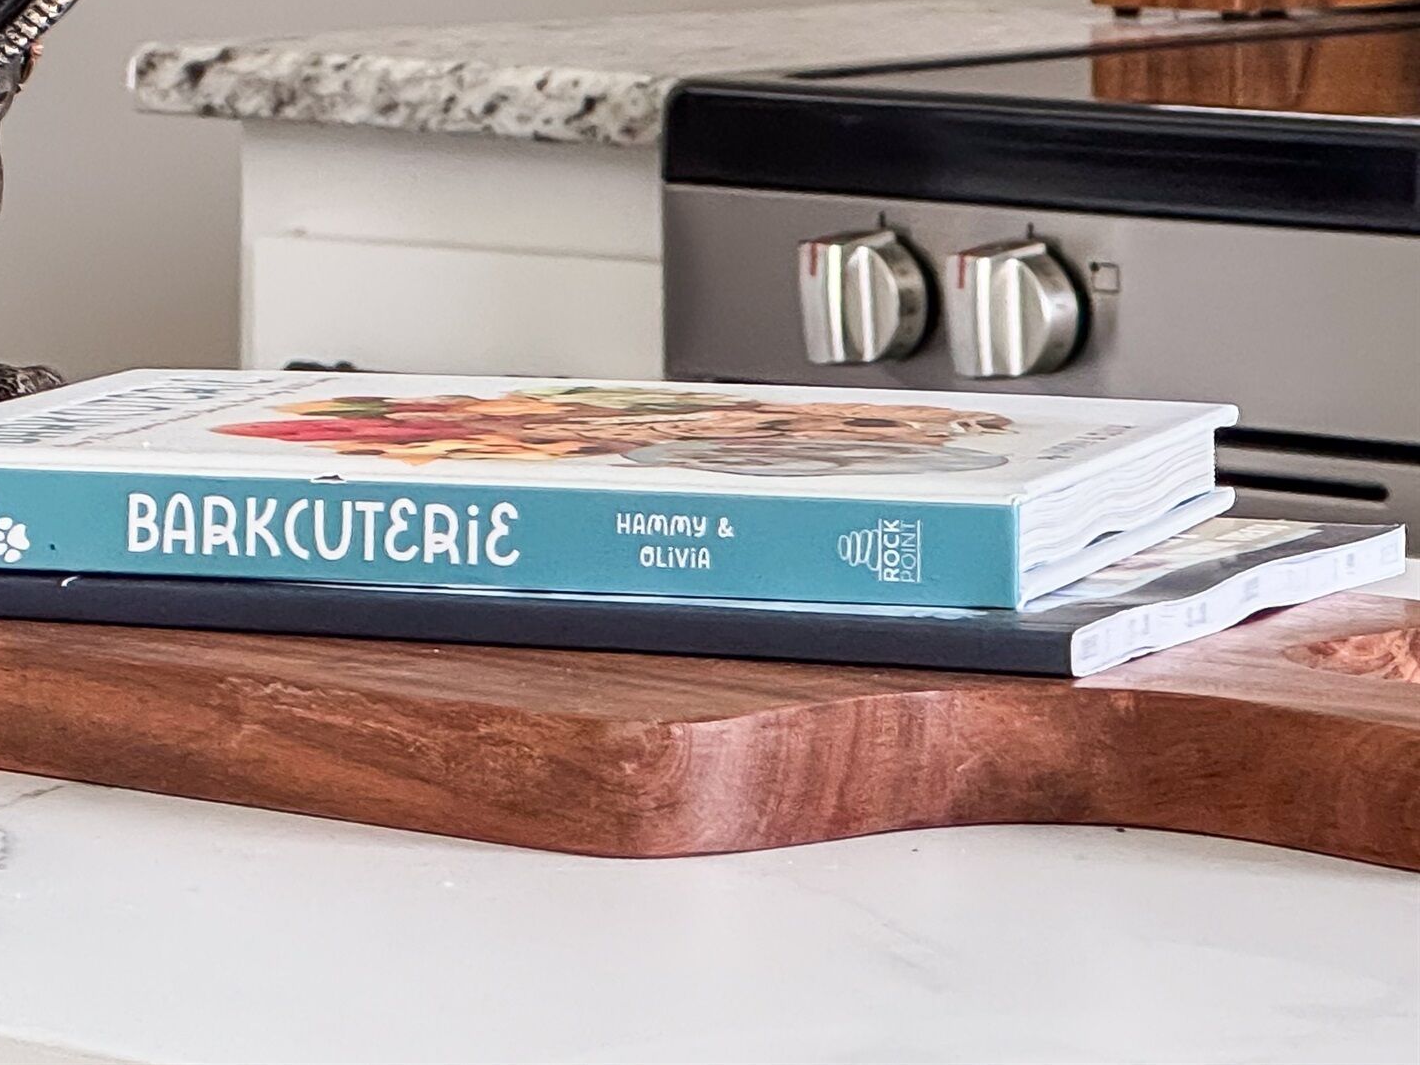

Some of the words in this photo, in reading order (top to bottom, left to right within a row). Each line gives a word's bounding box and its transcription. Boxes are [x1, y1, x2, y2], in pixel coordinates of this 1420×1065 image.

[616, 512, 707, 537] HAMMY
[717, 516, 735, 538] &
[883, 519, 900, 582] ROCK
[900, 520, 917, 583] POINT
